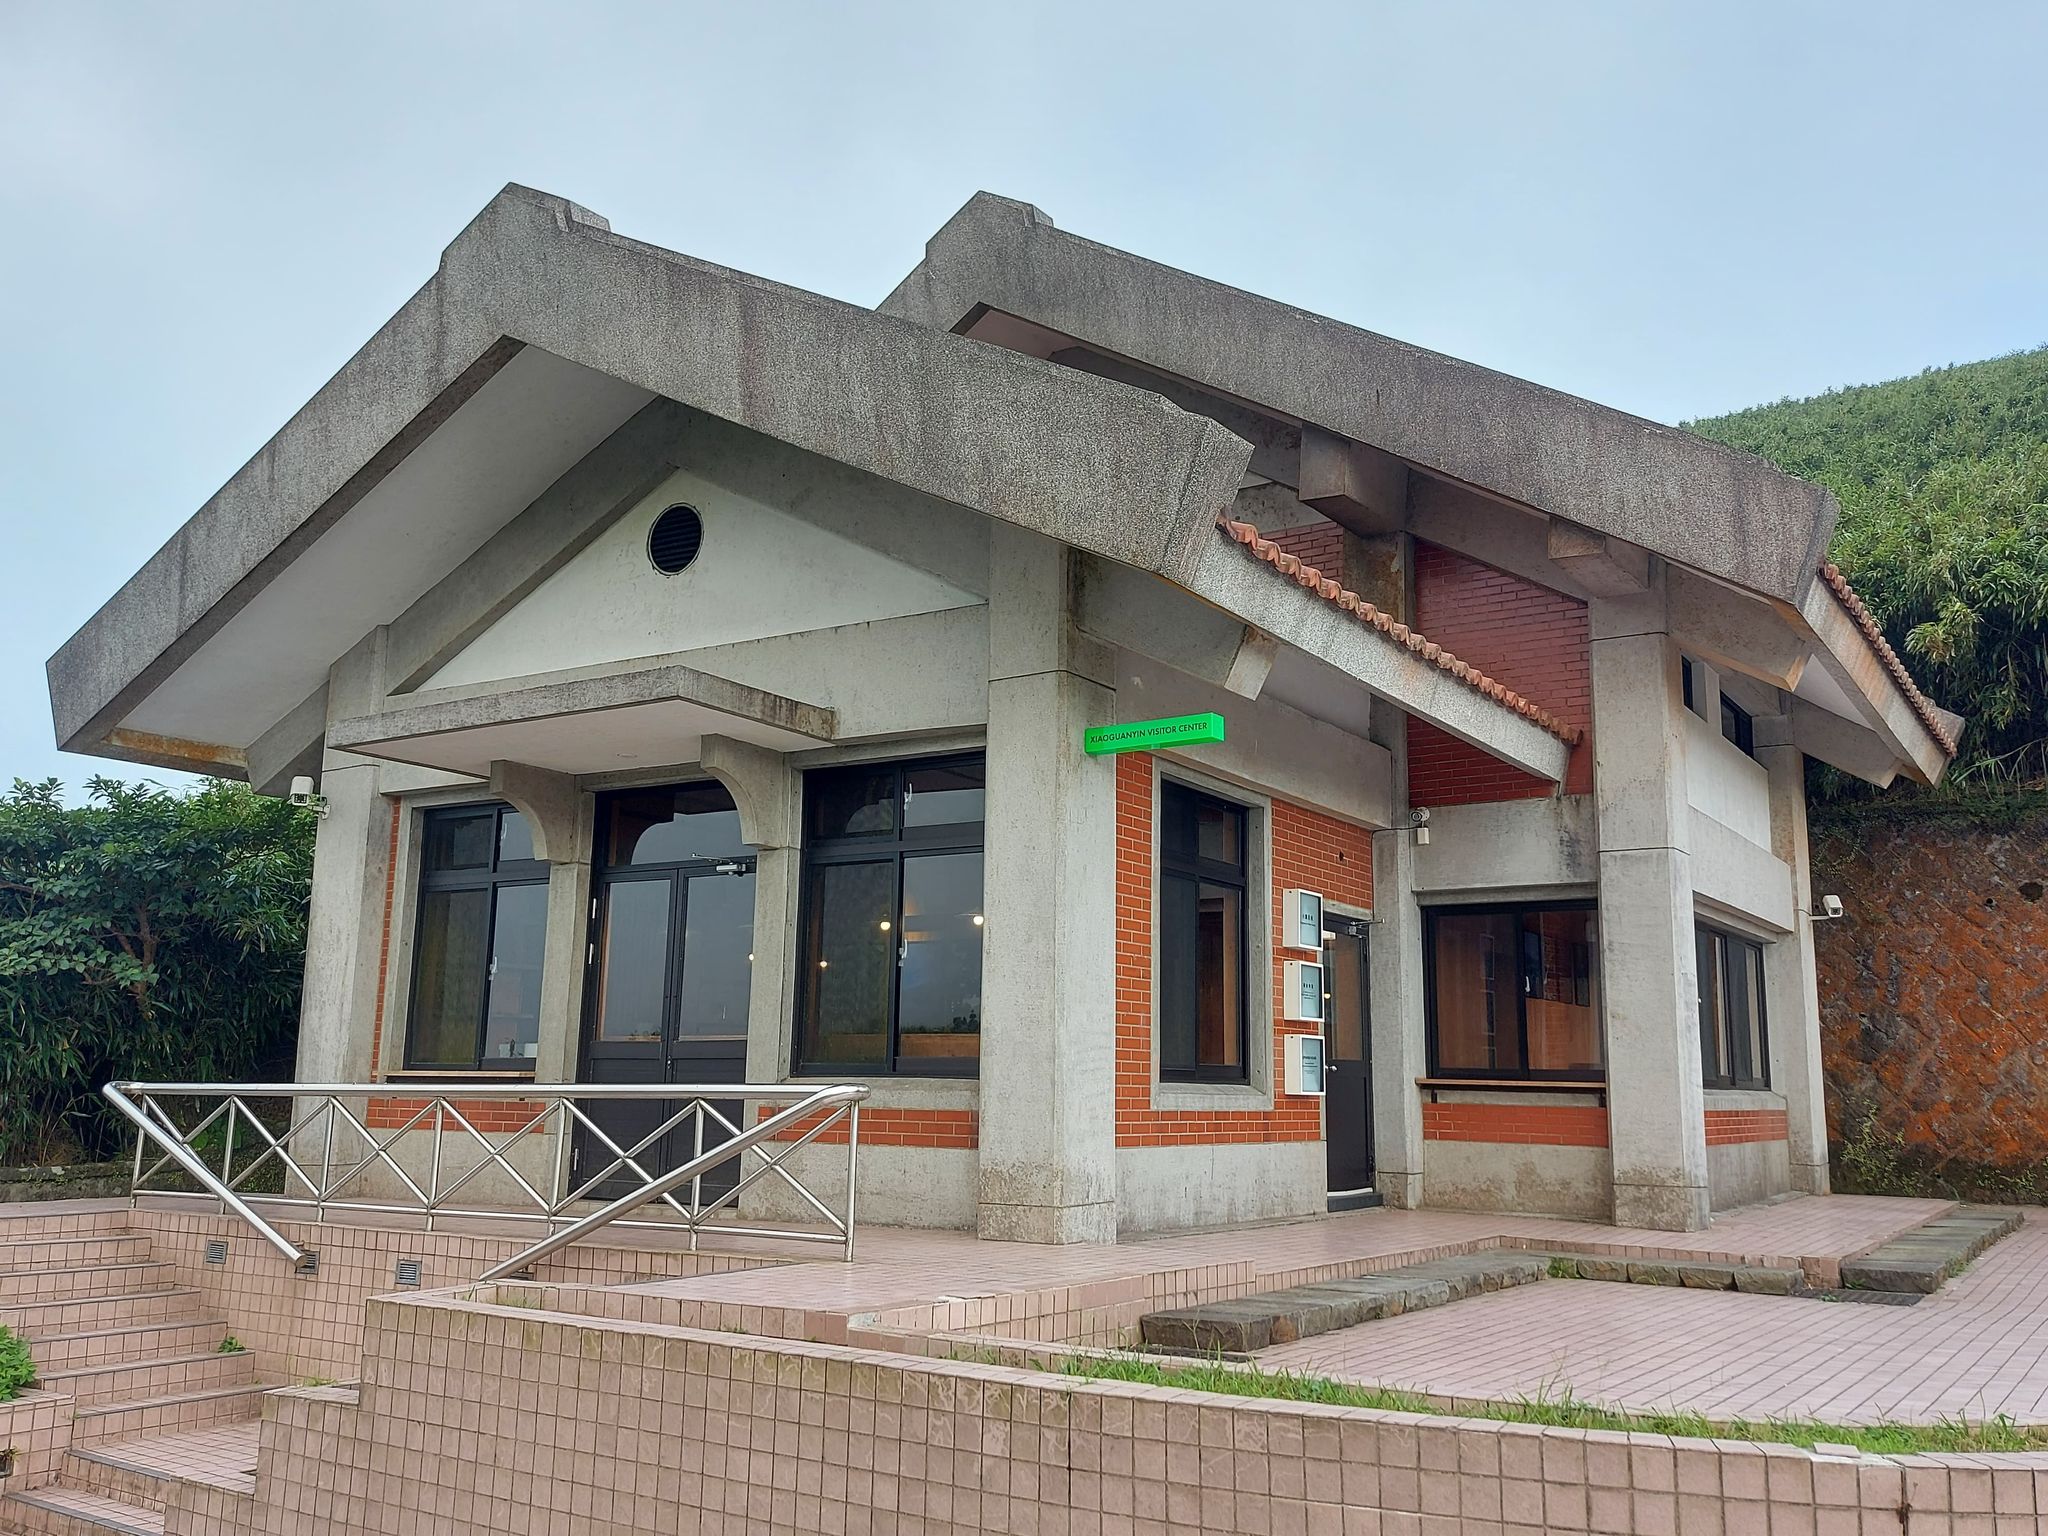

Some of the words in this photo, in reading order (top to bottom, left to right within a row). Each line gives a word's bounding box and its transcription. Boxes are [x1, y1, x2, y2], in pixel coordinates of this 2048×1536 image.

[1090, 730, 1146, 743] XIAOGUANYIN
[1147, 725, 1177, 736] VISITOR
[1178, 722, 1208, 732] CENTER
